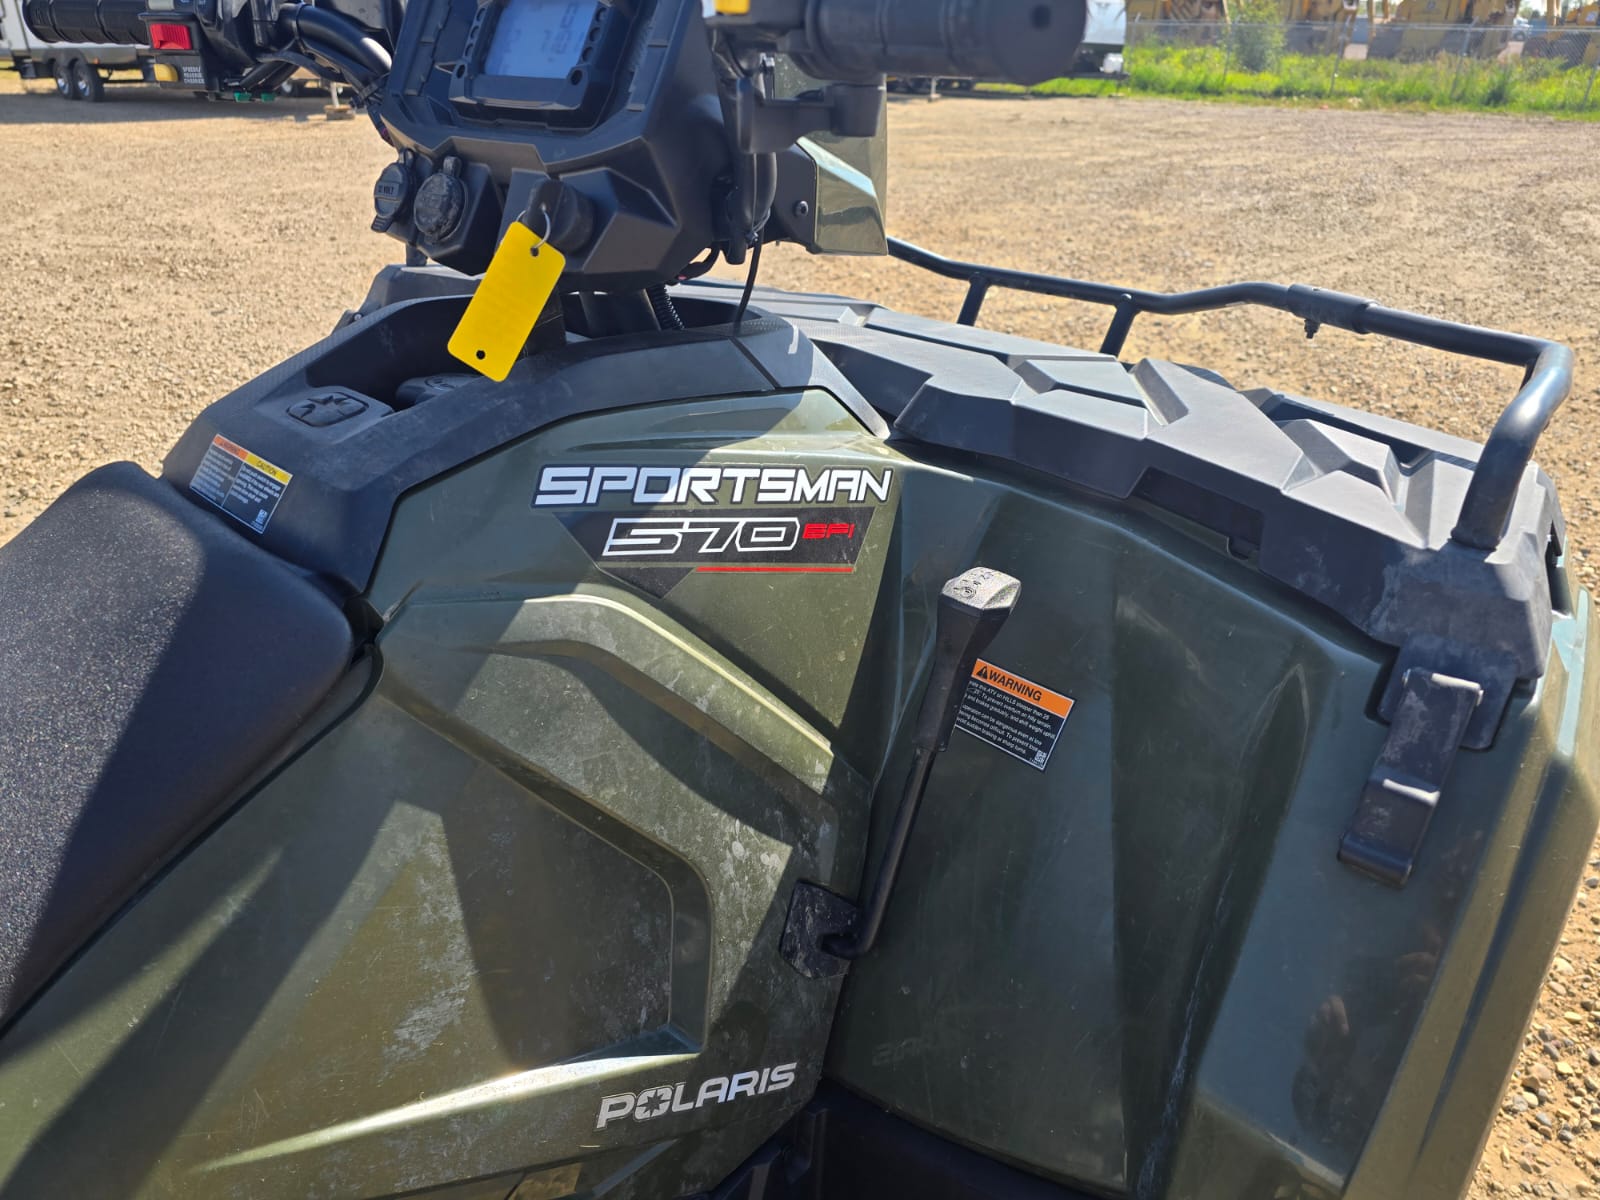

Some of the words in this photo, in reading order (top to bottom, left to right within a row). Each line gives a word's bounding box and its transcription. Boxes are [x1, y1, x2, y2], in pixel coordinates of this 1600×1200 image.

[255, 460, 277, 476] CAUTION
[534, 466, 893, 505] SPORTSMAN
[602, 516, 800, 557] 570
[986, 687, 997, 695] ATV
[1002, 694, 1016, 705] HILLS
[986, 695, 1003, 708] prevent
[989, 669, 1042, 702] WARNING
[596, 1062, 797, 1129] POLARIS
